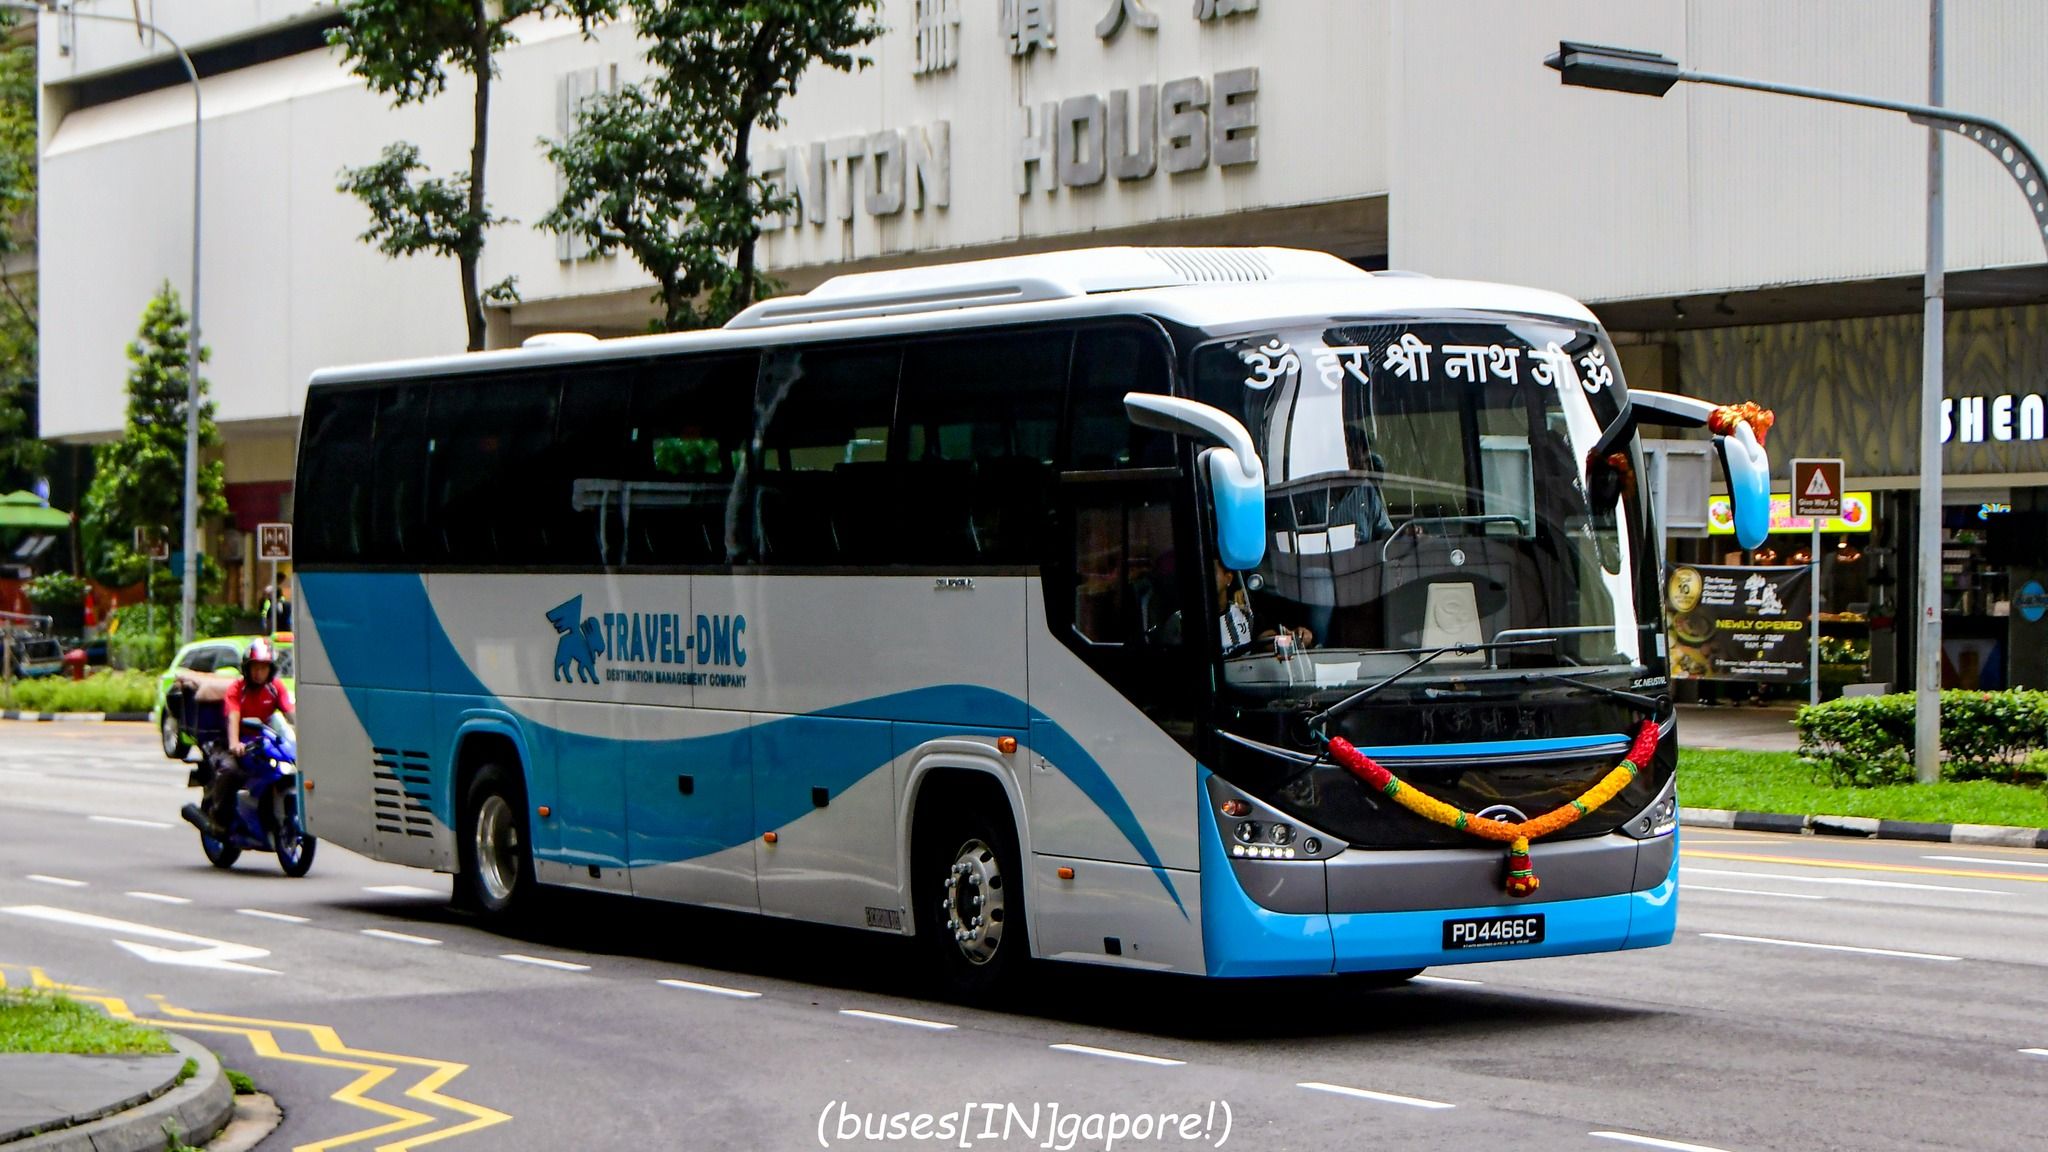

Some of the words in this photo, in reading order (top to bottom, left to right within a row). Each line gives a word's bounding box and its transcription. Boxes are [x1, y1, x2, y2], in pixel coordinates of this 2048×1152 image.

[1012, 67, 1259, 196] HOUSE
[1311, 344, 1369, 390] हर
[1382, 333, 1432, 383] श्री
[1442, 344, 1520, 385] नाथ
[1528, 341, 1571, 389] जी
[1829, 498, 1839, 507] To
[1715, 619, 1754, 630] NEWLY
[1755, 620, 1803, 631] OPENED
[604, 612, 747, 668] TRAVEL-DMC
[606, 668, 654, 684] DESTINATION
[655, 671, 708, 687] MANAGEMENT
[709, 673, 747, 688] COMPANY
[1453, 918, 1537, 943] PD4466C
